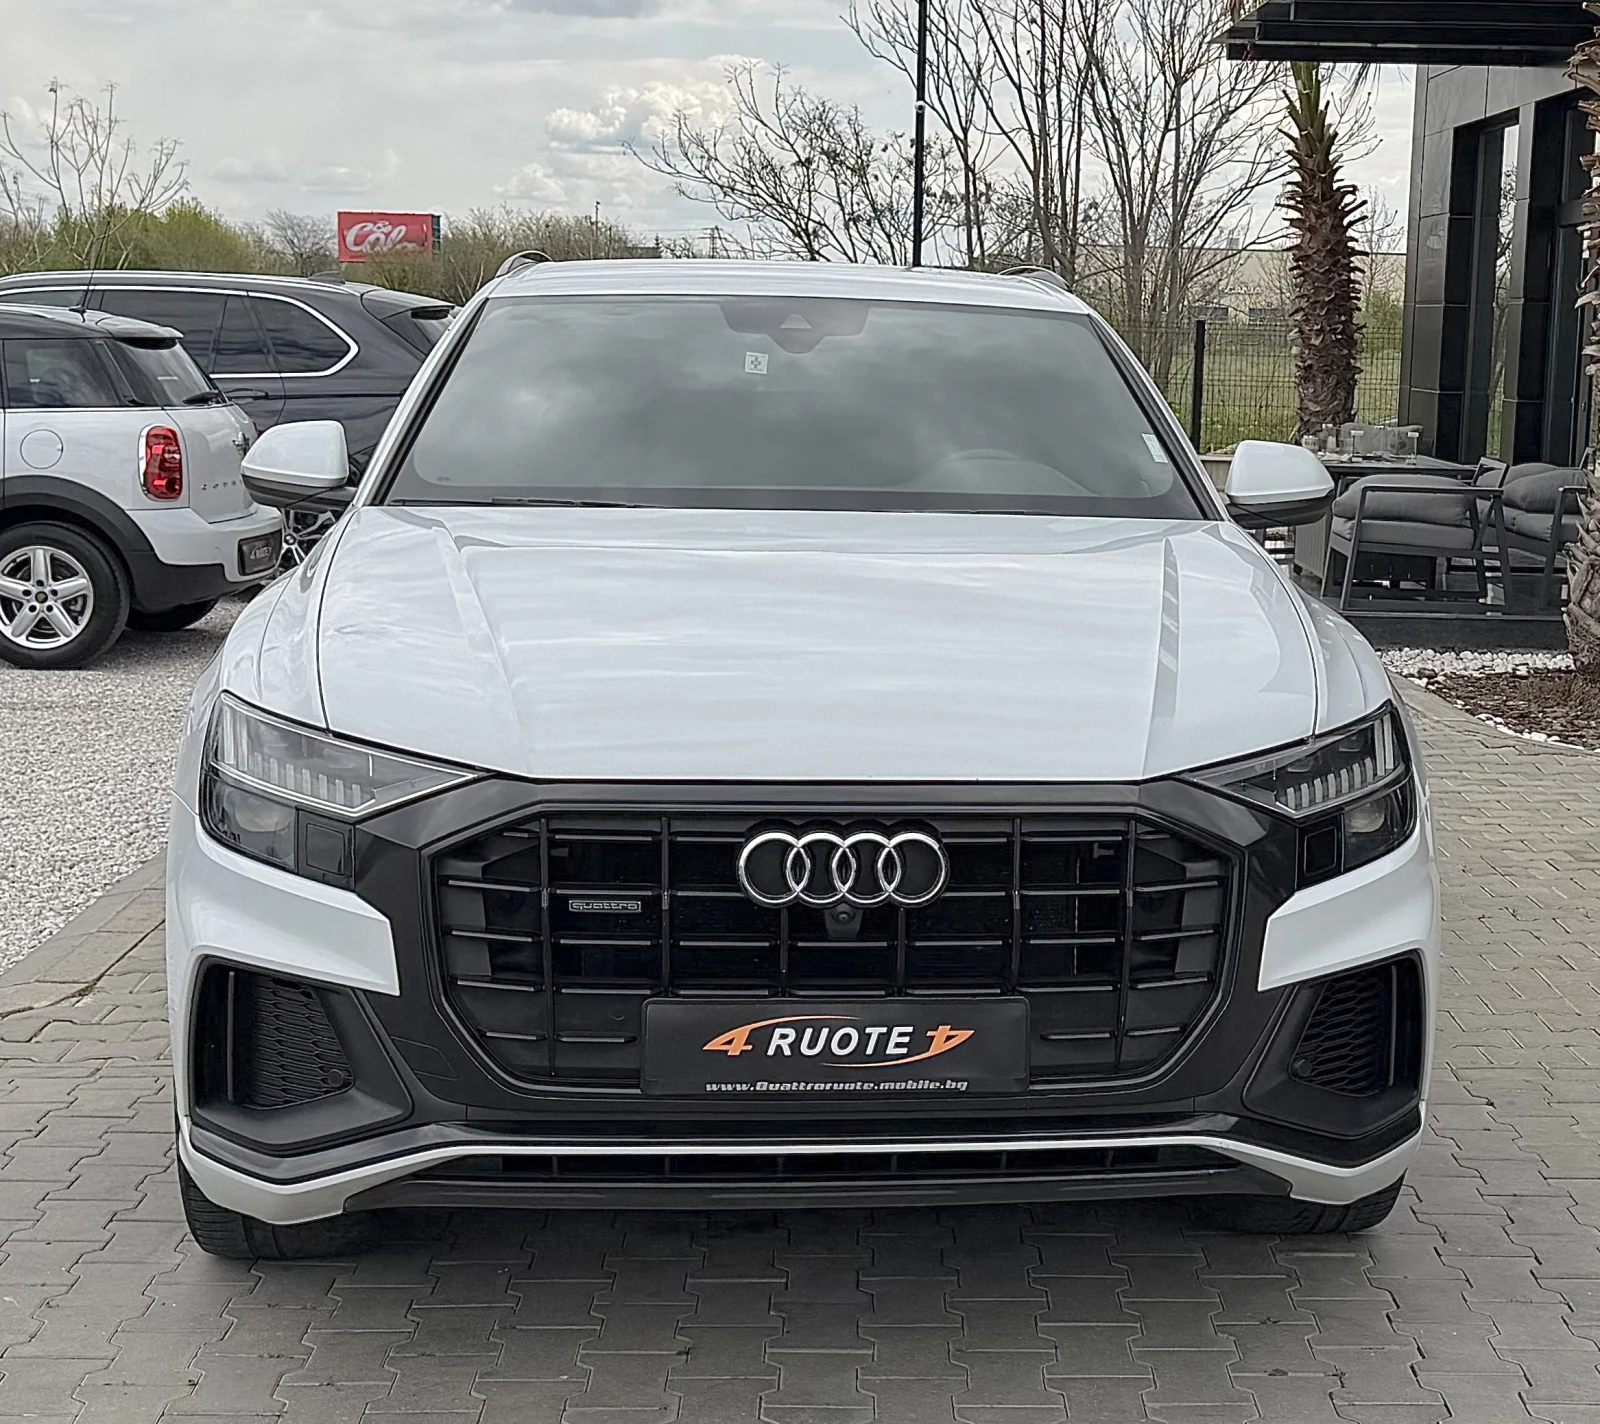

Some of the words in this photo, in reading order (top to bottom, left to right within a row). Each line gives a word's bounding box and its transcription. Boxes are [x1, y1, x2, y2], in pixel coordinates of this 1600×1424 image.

[571, 902, 638, 911] quattro
[702, 1027, 754, 1057] 4
[766, 1025, 915, 1057] RUOTE
